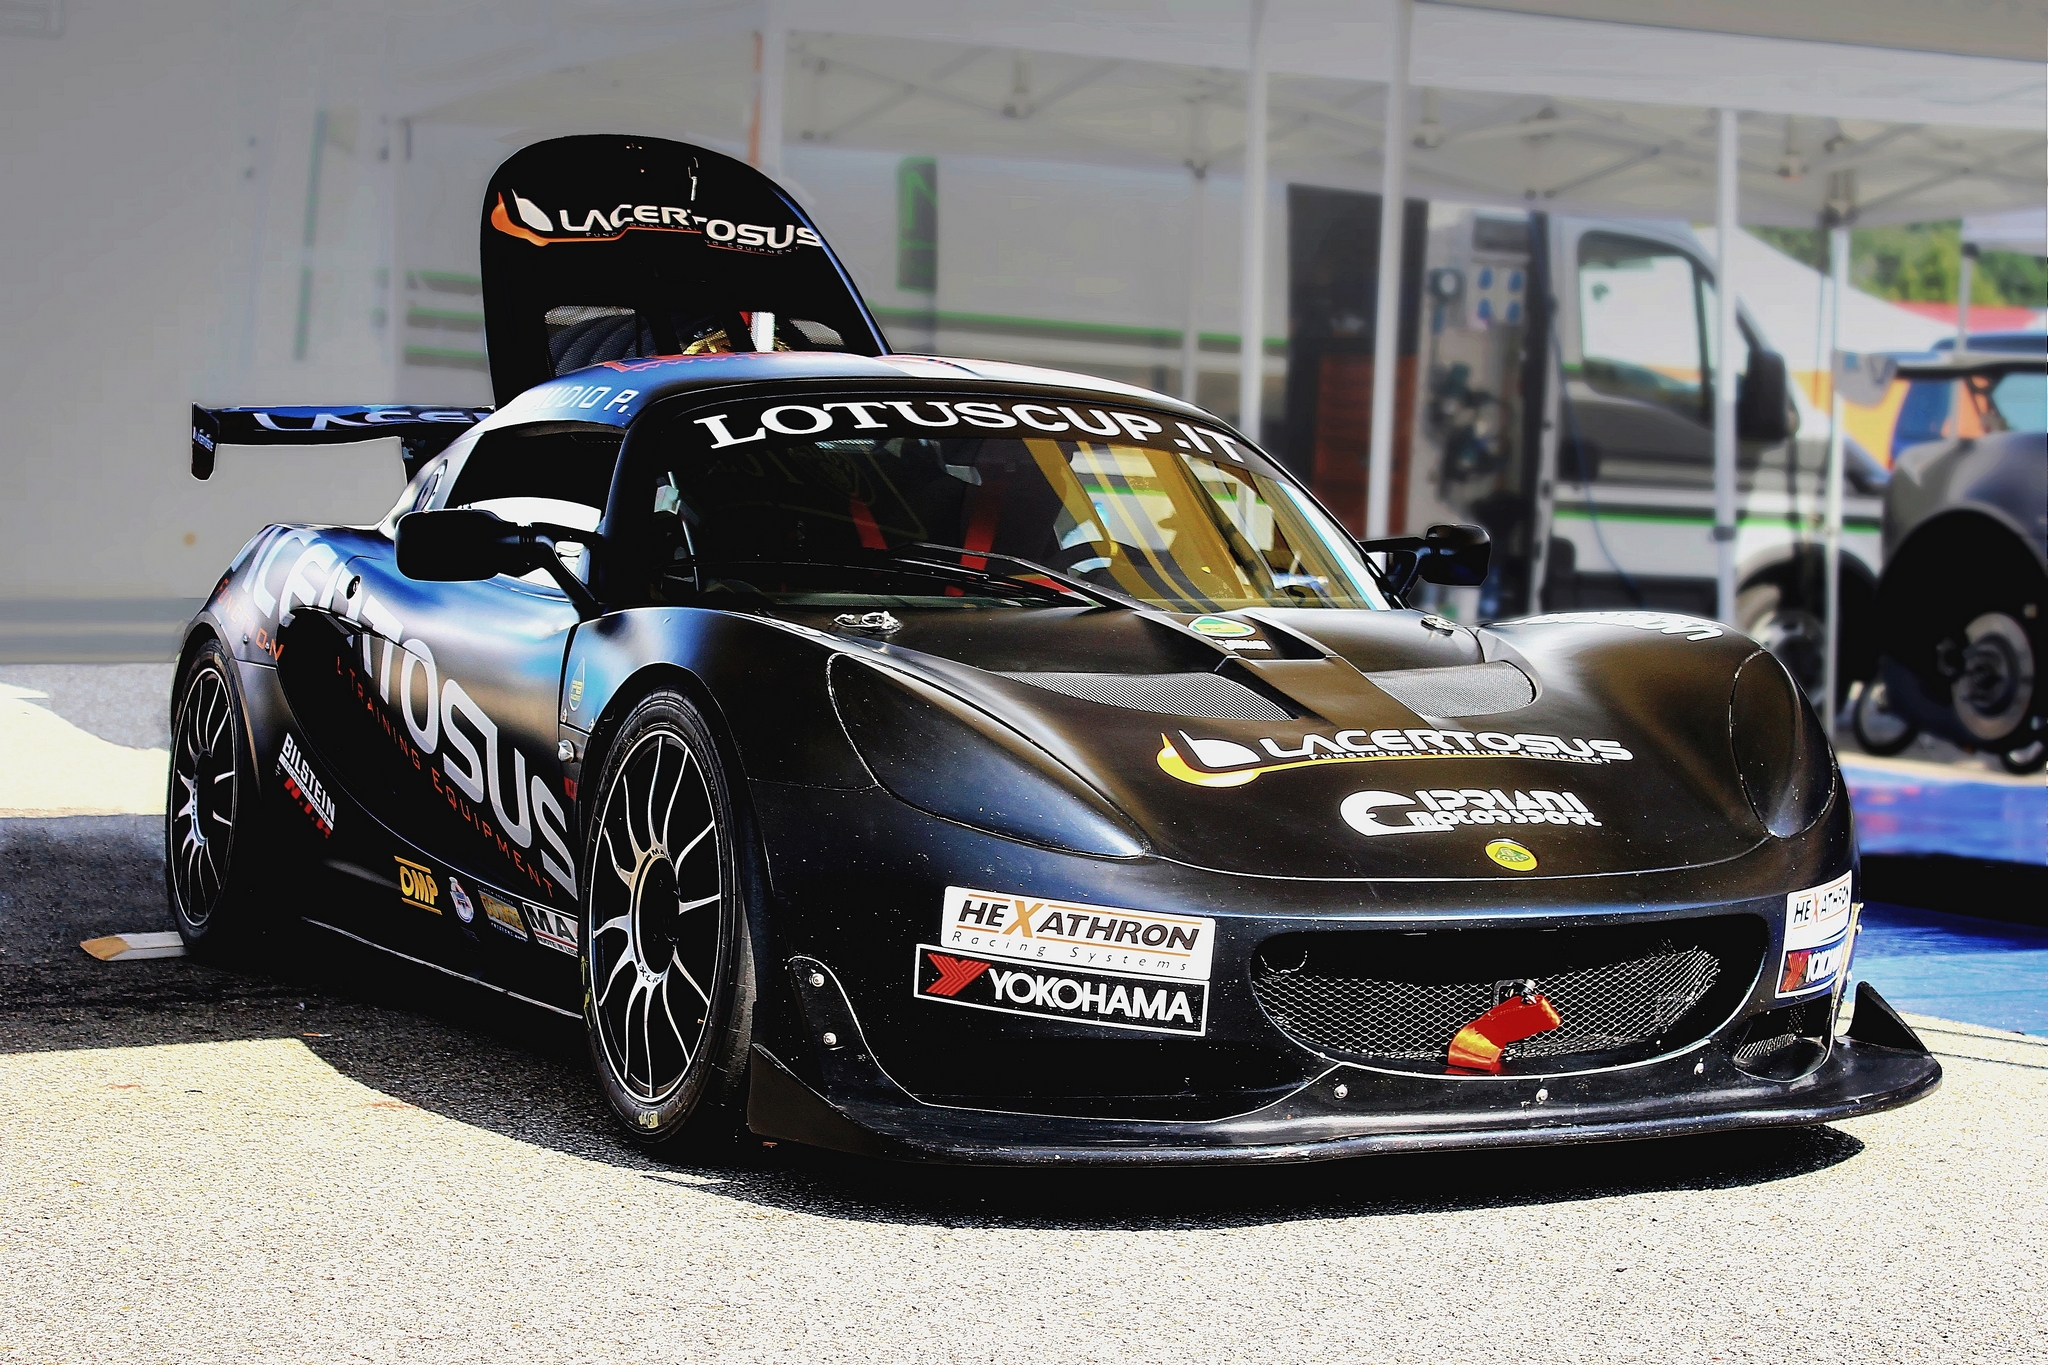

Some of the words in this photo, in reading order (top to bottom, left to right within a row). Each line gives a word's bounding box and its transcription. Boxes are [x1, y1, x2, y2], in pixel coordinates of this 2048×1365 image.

[558, 203, 825, 250] LACERTOSUS
[253, 409, 490, 432] LACE
[603, 389, 639, 417] P.
[1259, 729, 1635, 763] LACERTOSUS
[1309, 749, 1422, 761] FUNCTIONAL
[1429, 748, 1512, 756] TRAINING
[281, 732, 337, 823] BILSTEIN
[348, 667, 421, 771] TRAINING
[431, 767, 554, 899] EQUIPMENT
[400, 865, 439, 906] OMP
[958, 898, 1200, 951] HEXATHRON
[951, 931, 1047, 958] Racing
[1069, 946, 1188, 972] Systems
[987, 966, 1194, 1024] YOKOHAMA
